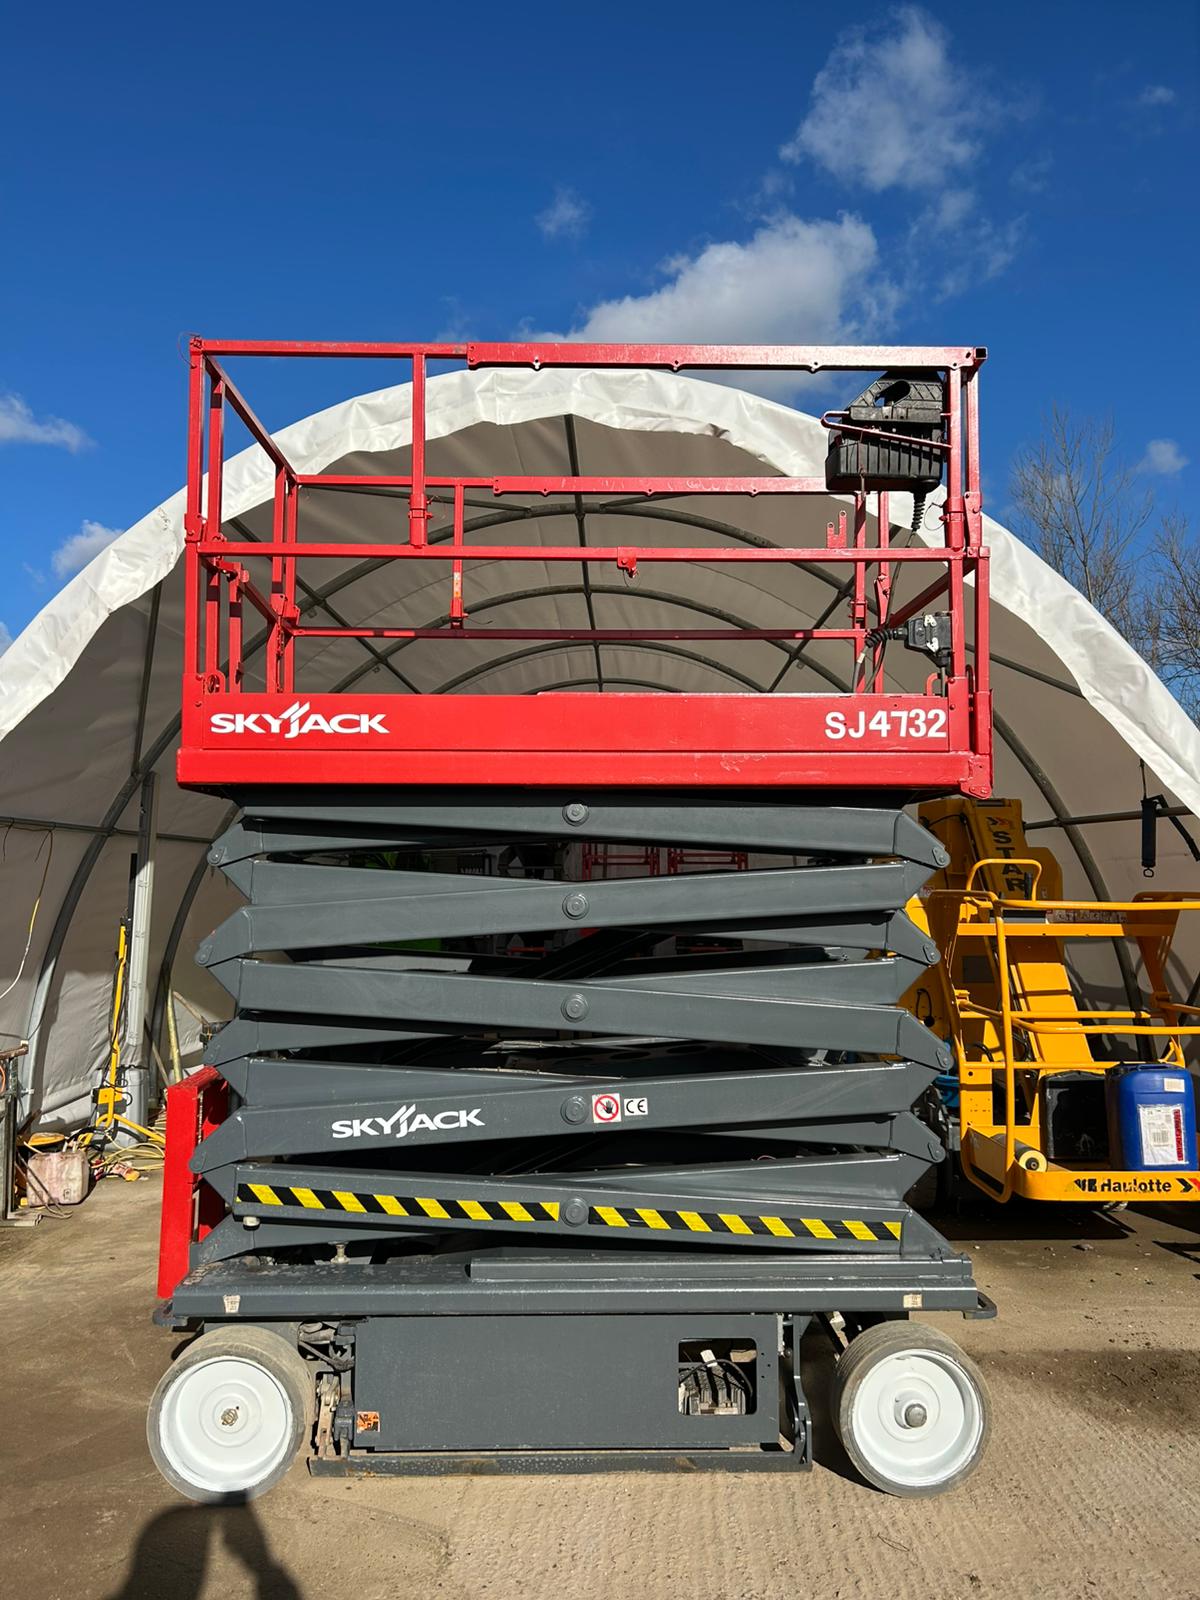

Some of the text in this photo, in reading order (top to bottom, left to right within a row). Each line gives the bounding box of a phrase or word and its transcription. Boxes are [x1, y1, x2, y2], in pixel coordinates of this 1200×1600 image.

[210, 701, 390, 738] SKYJACK
[825, 708, 947, 740] SJ4732
[992, 830, 1025, 892] STAR
[331, 1103, 486, 1139] SKYJACK
[1101, 1178, 1172, 1193] Haulotte
